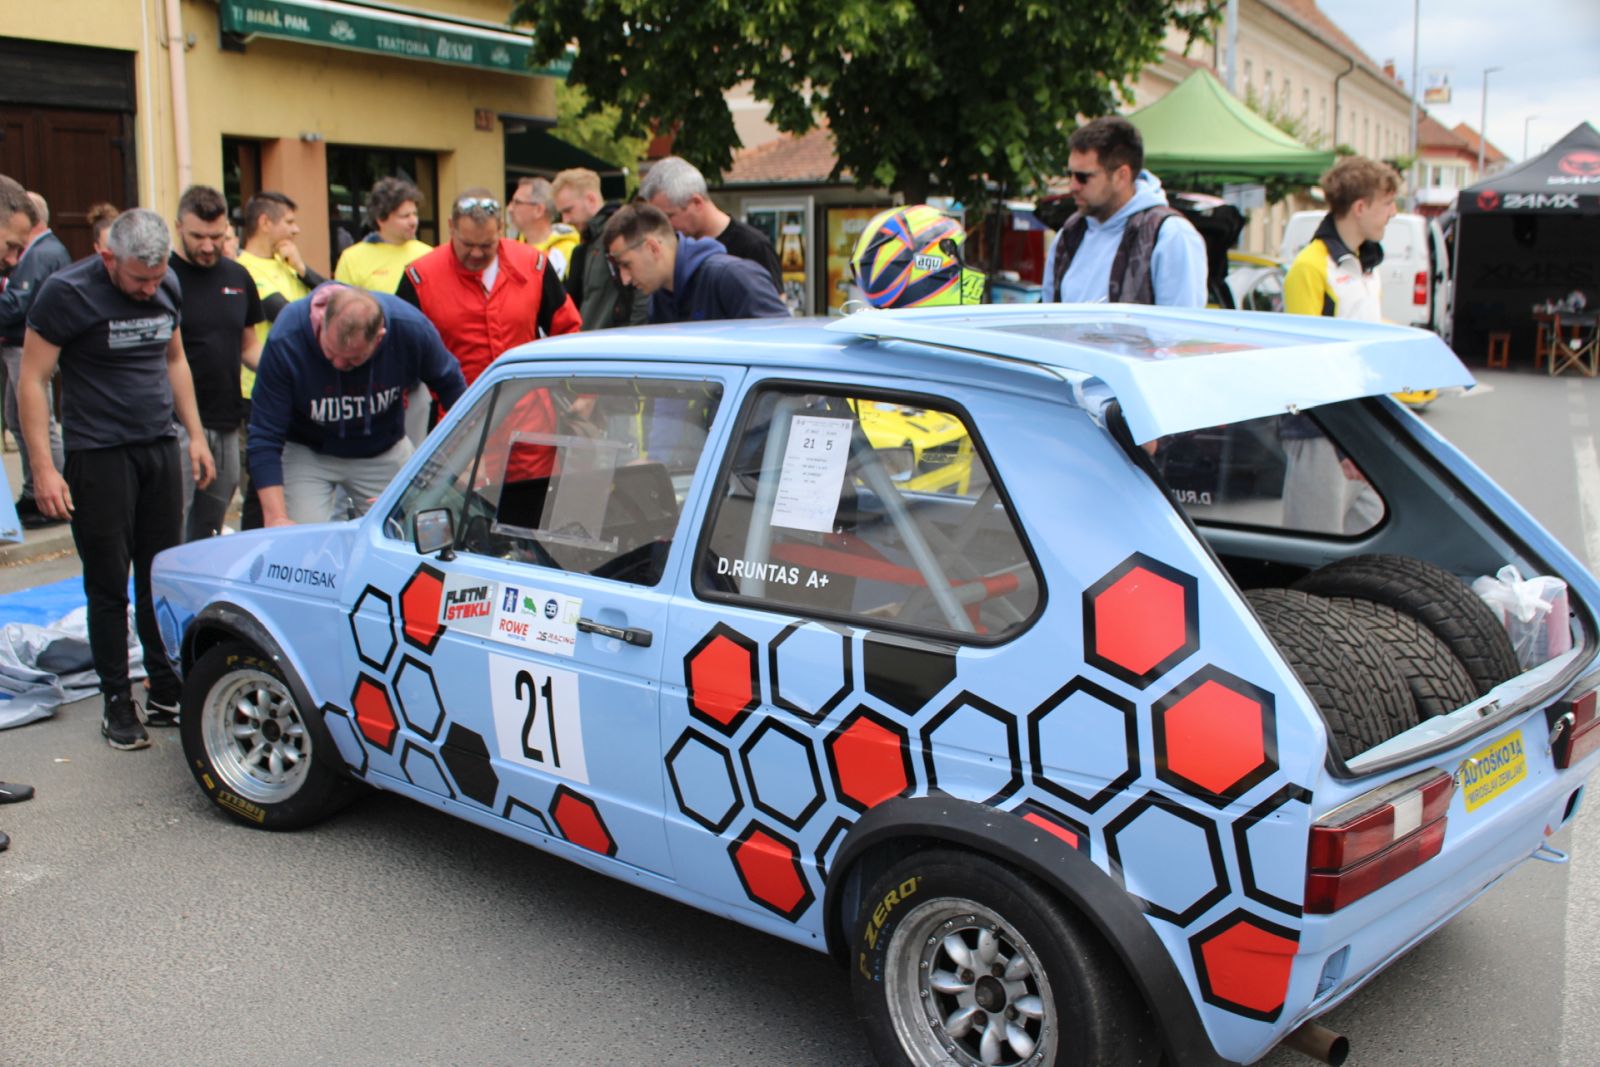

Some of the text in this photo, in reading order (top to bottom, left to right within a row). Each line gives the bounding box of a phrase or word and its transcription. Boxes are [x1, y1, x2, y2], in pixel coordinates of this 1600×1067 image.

[376, 35, 430, 56] TRATTORIA
[1547, 175, 1600, 185] 24M
[1502, 193, 1579, 209] 24MX
[803, 437, 833, 451] 21 5
[294, 567, 337, 589] OTISAK
[717, 557, 829, 588] D.RUNTAS A+
[447, 601, 491, 621] STEKLI
[499, 618, 530, 637] ROWE
[515, 670, 561, 768] 21
[864, 877, 918, 950] ZERO
